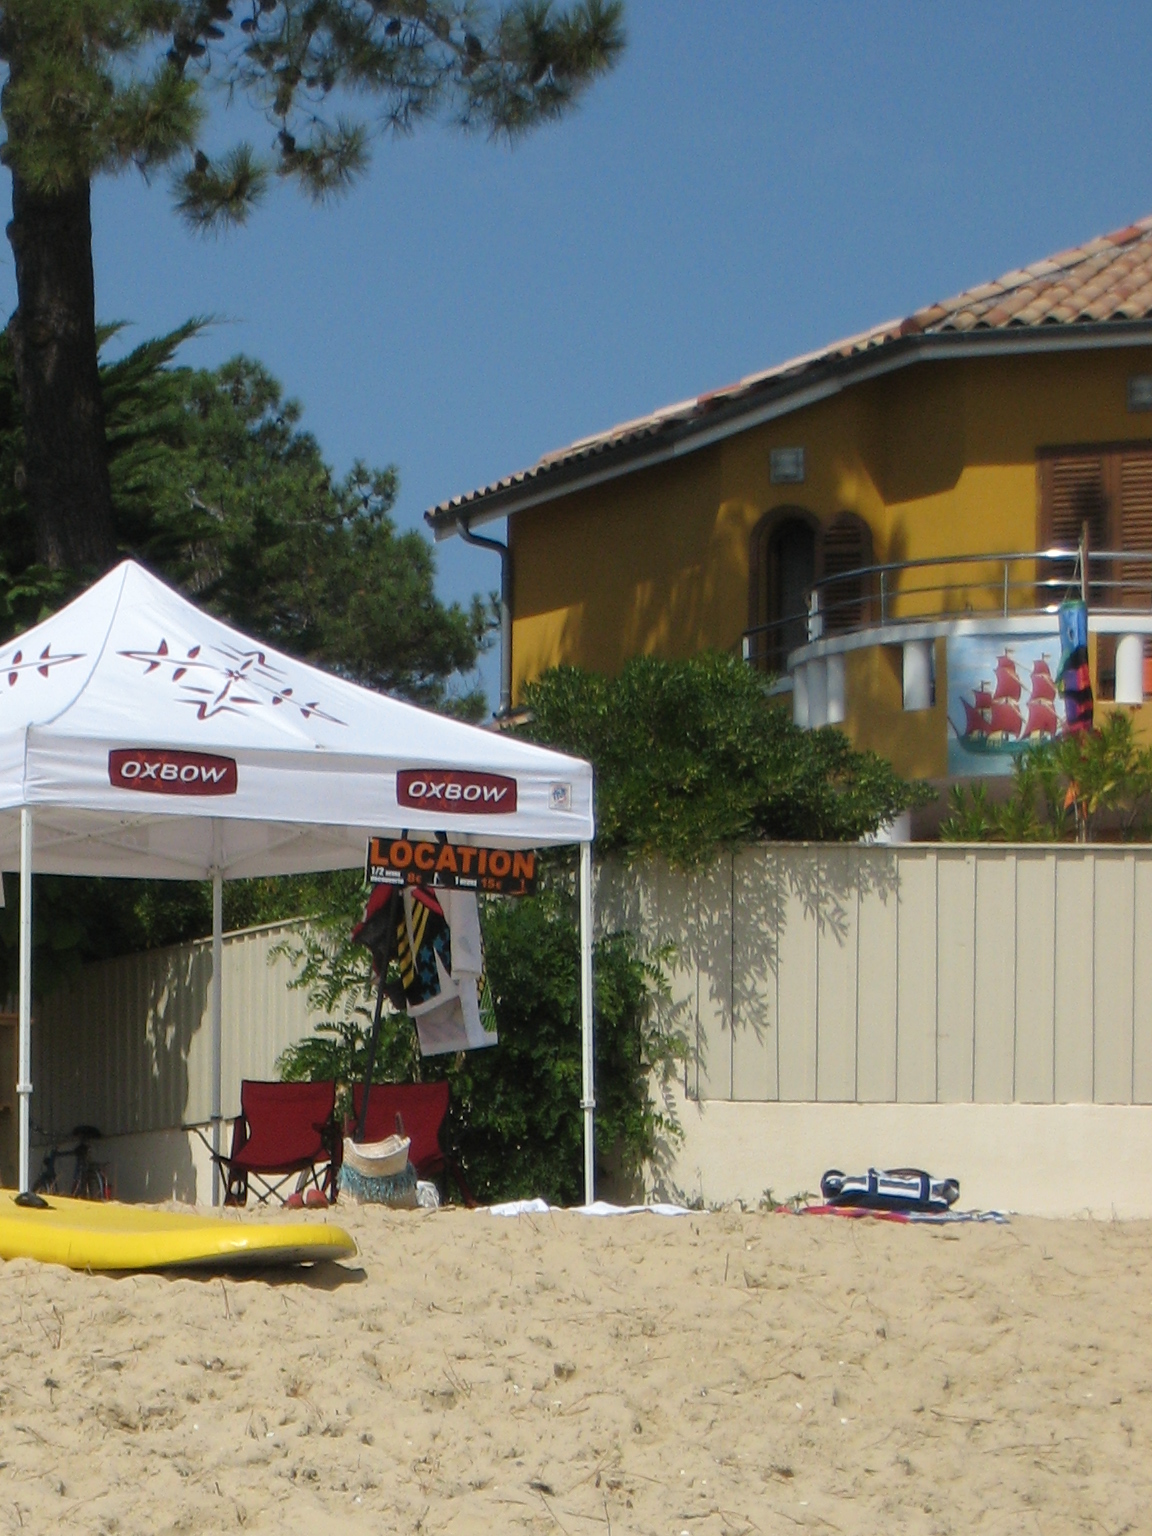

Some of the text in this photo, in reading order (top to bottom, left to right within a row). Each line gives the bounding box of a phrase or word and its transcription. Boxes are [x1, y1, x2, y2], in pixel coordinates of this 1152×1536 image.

[120, 760, 228, 783] OXBOW
[407, 780, 507, 803] OXBOW
[370, 837, 536, 879] LOCATION
